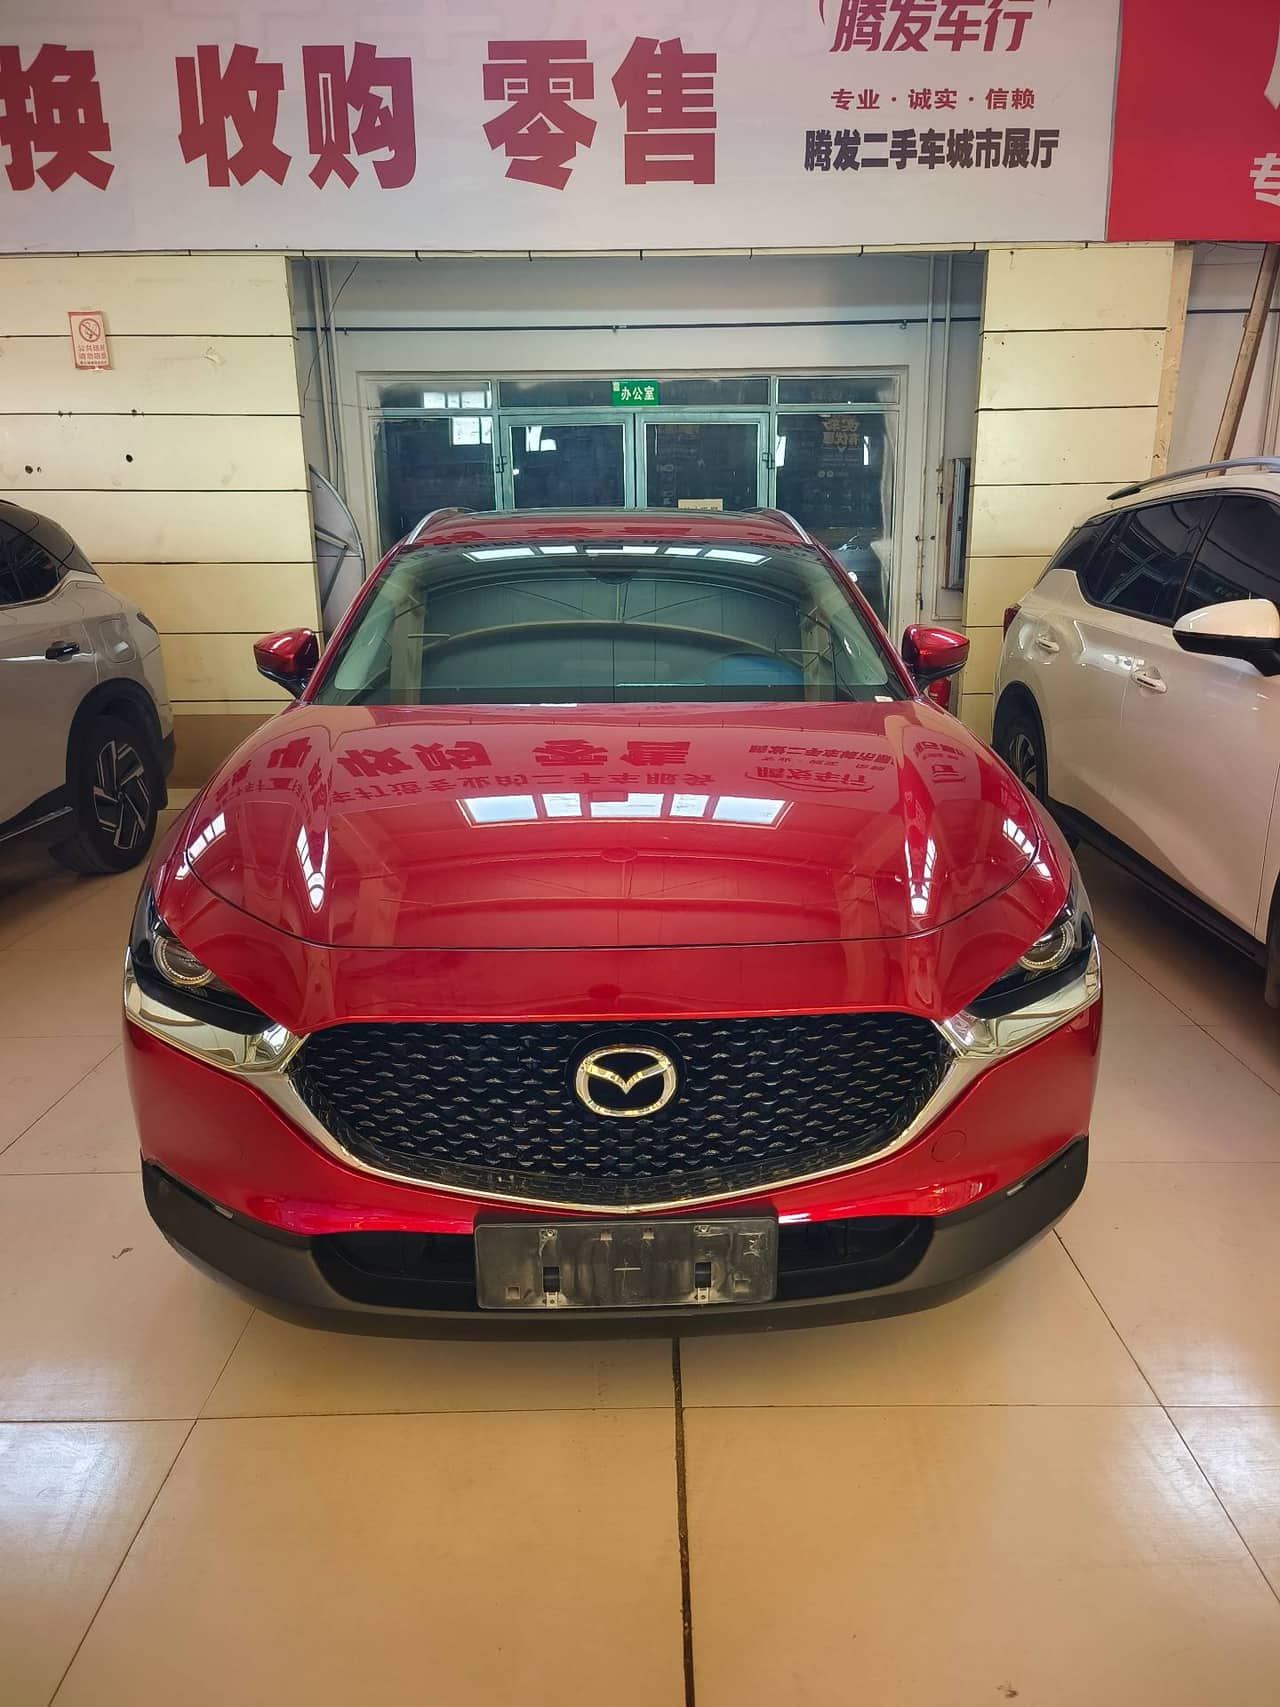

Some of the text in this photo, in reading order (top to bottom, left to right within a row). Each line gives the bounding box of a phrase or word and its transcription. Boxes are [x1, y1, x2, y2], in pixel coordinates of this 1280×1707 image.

[829, 0, 1033, 52] 腾发车行
[0, 37, 718, 192] 换 收购 零售
[804, 127, 1060, 171] 腾发二手车城市展厅
[621, 385, 655, 401] 办公室
